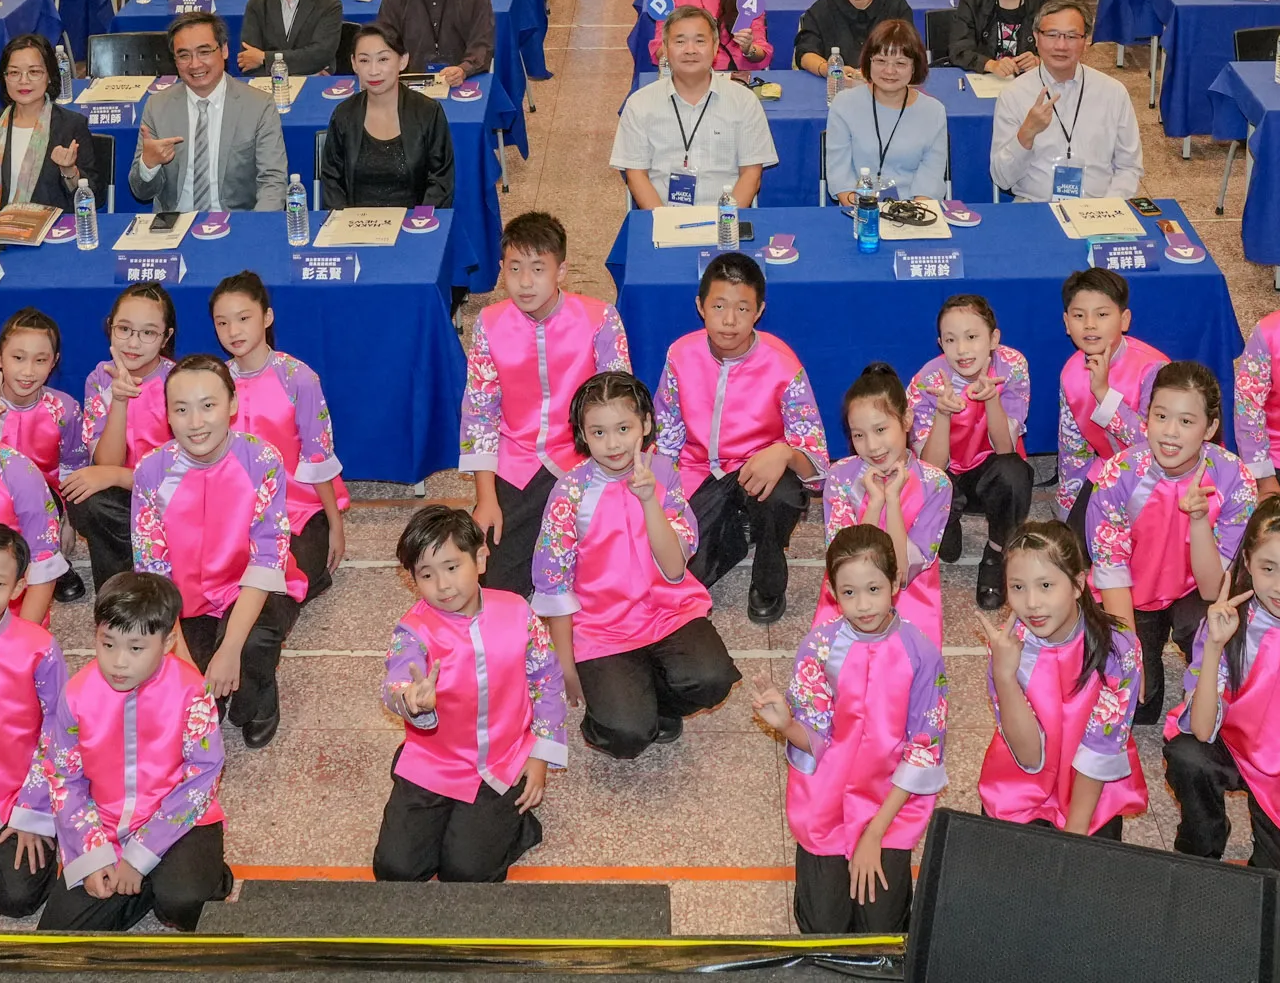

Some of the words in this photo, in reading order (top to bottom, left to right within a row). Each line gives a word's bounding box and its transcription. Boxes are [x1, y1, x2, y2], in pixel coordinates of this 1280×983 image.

[88, 114, 122, 125] 羅烈師
[1106, 255, 1146, 270] 馮祥勇
[127, 268, 167, 281] 陳邦畛
[301, 266, 342, 280] 彭孟賢
[910, 264, 950, 277] 黃淑鈴
